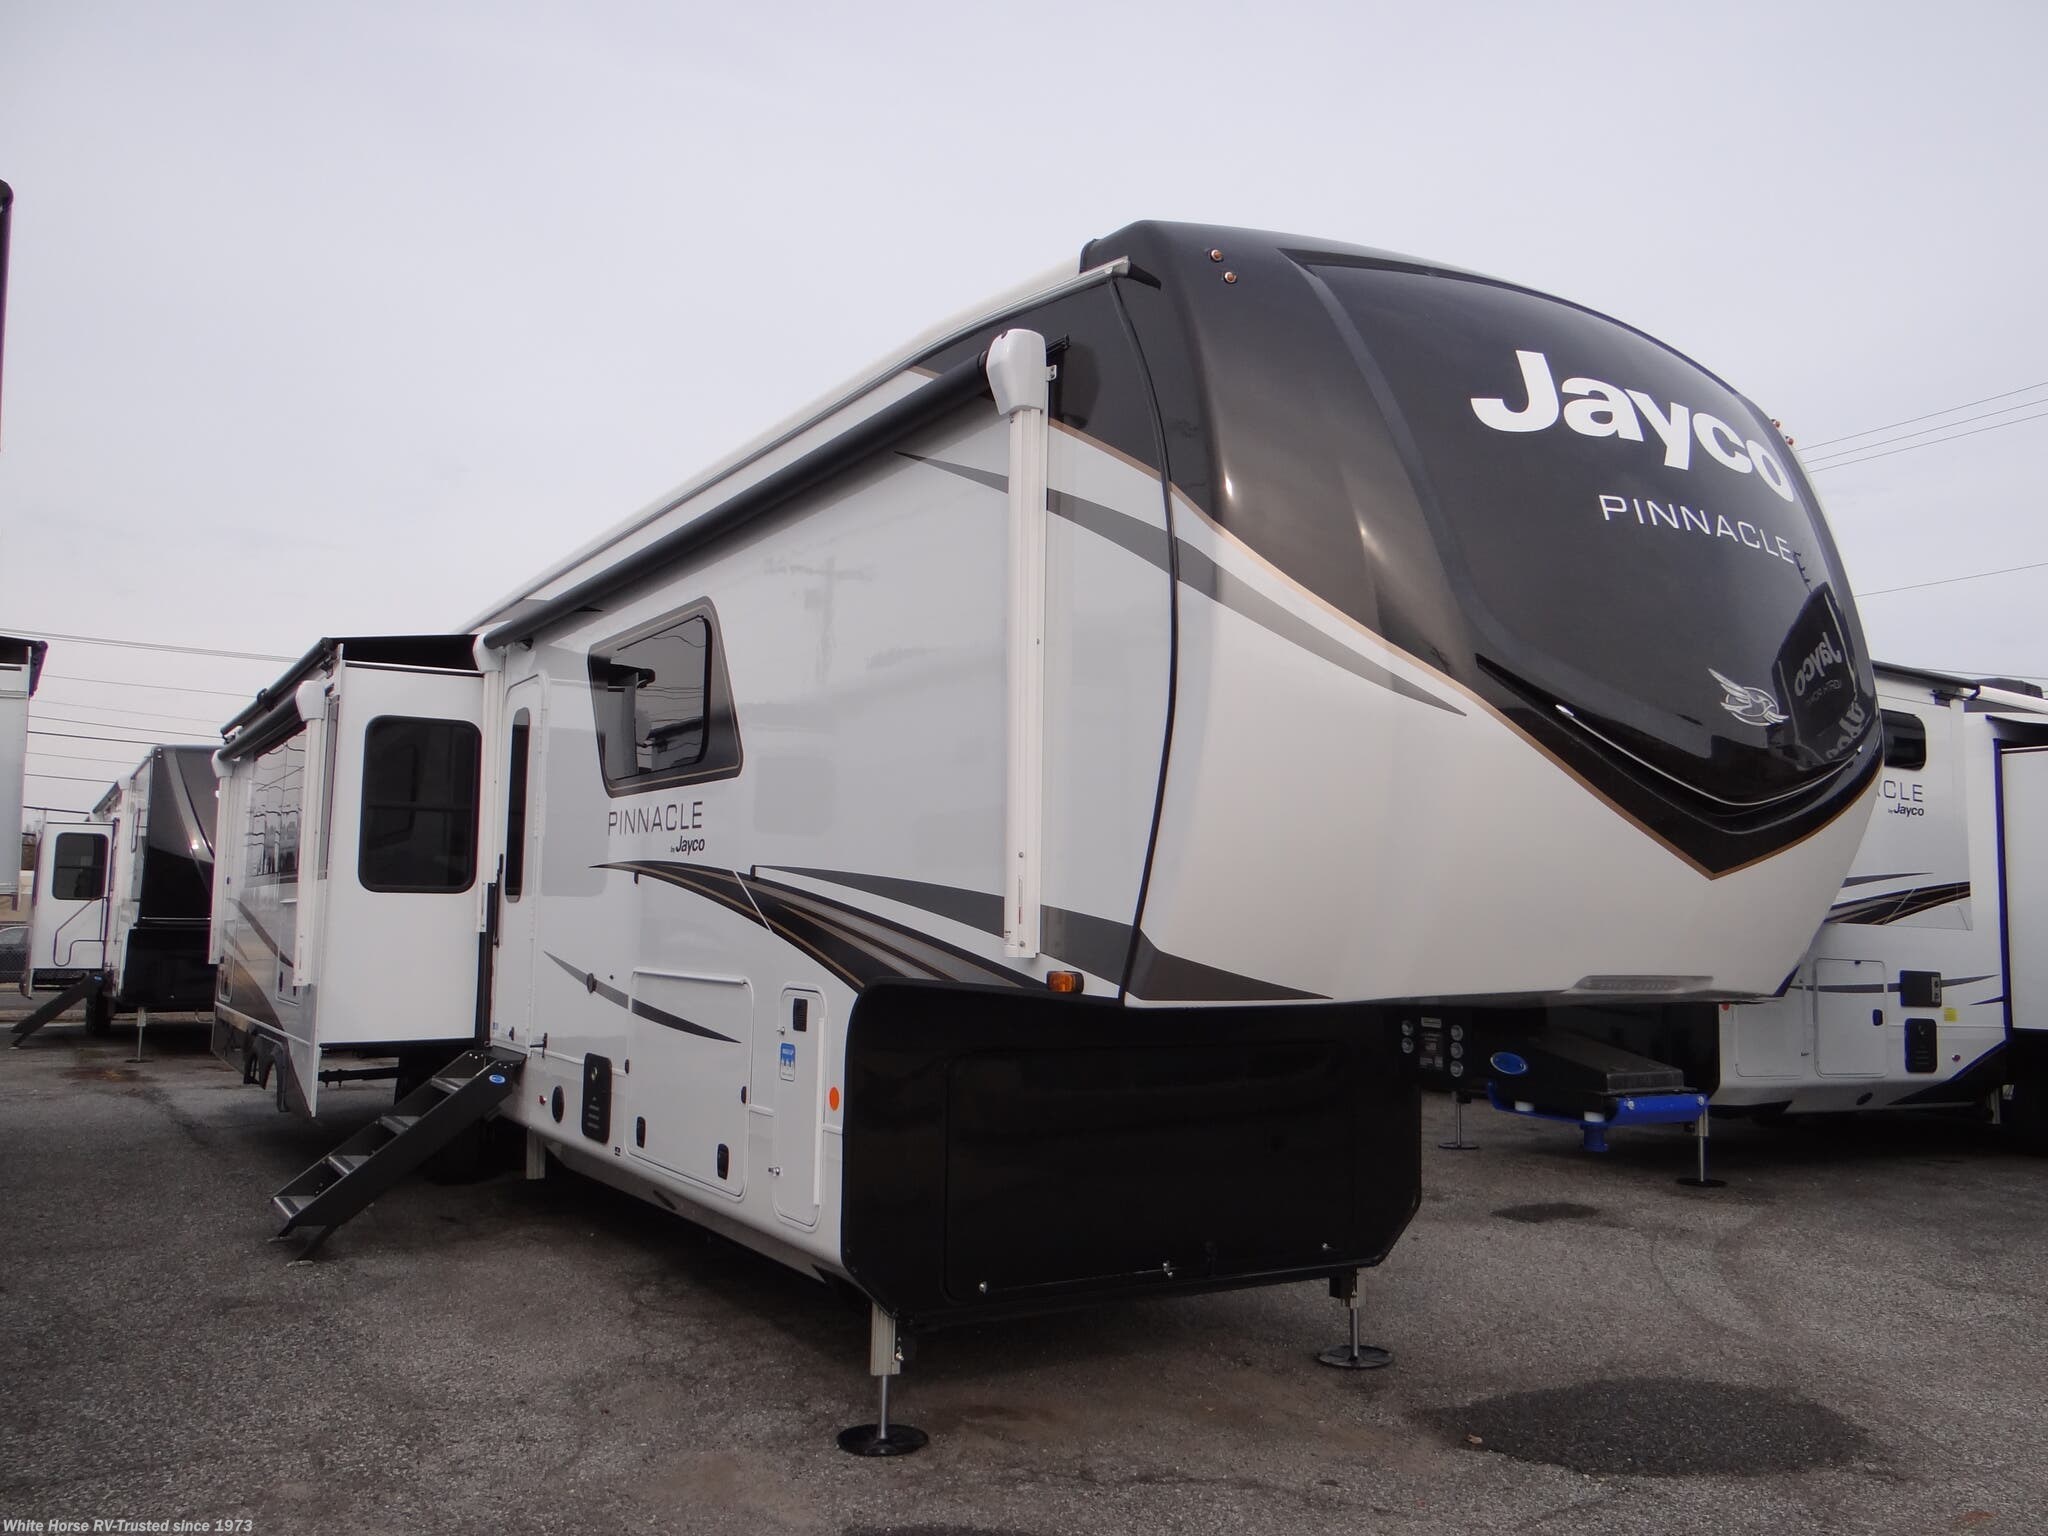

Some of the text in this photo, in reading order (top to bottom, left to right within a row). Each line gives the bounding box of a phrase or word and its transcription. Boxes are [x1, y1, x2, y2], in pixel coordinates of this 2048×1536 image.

[1470, 350, 1794, 502] Jayco
[1599, 494, 1795, 563] PINNACLE
[608, 801, 703, 836] PINNACLE
[1894, 802, 1925, 818] Jayco
[676, 836, 705, 856] Jayco
